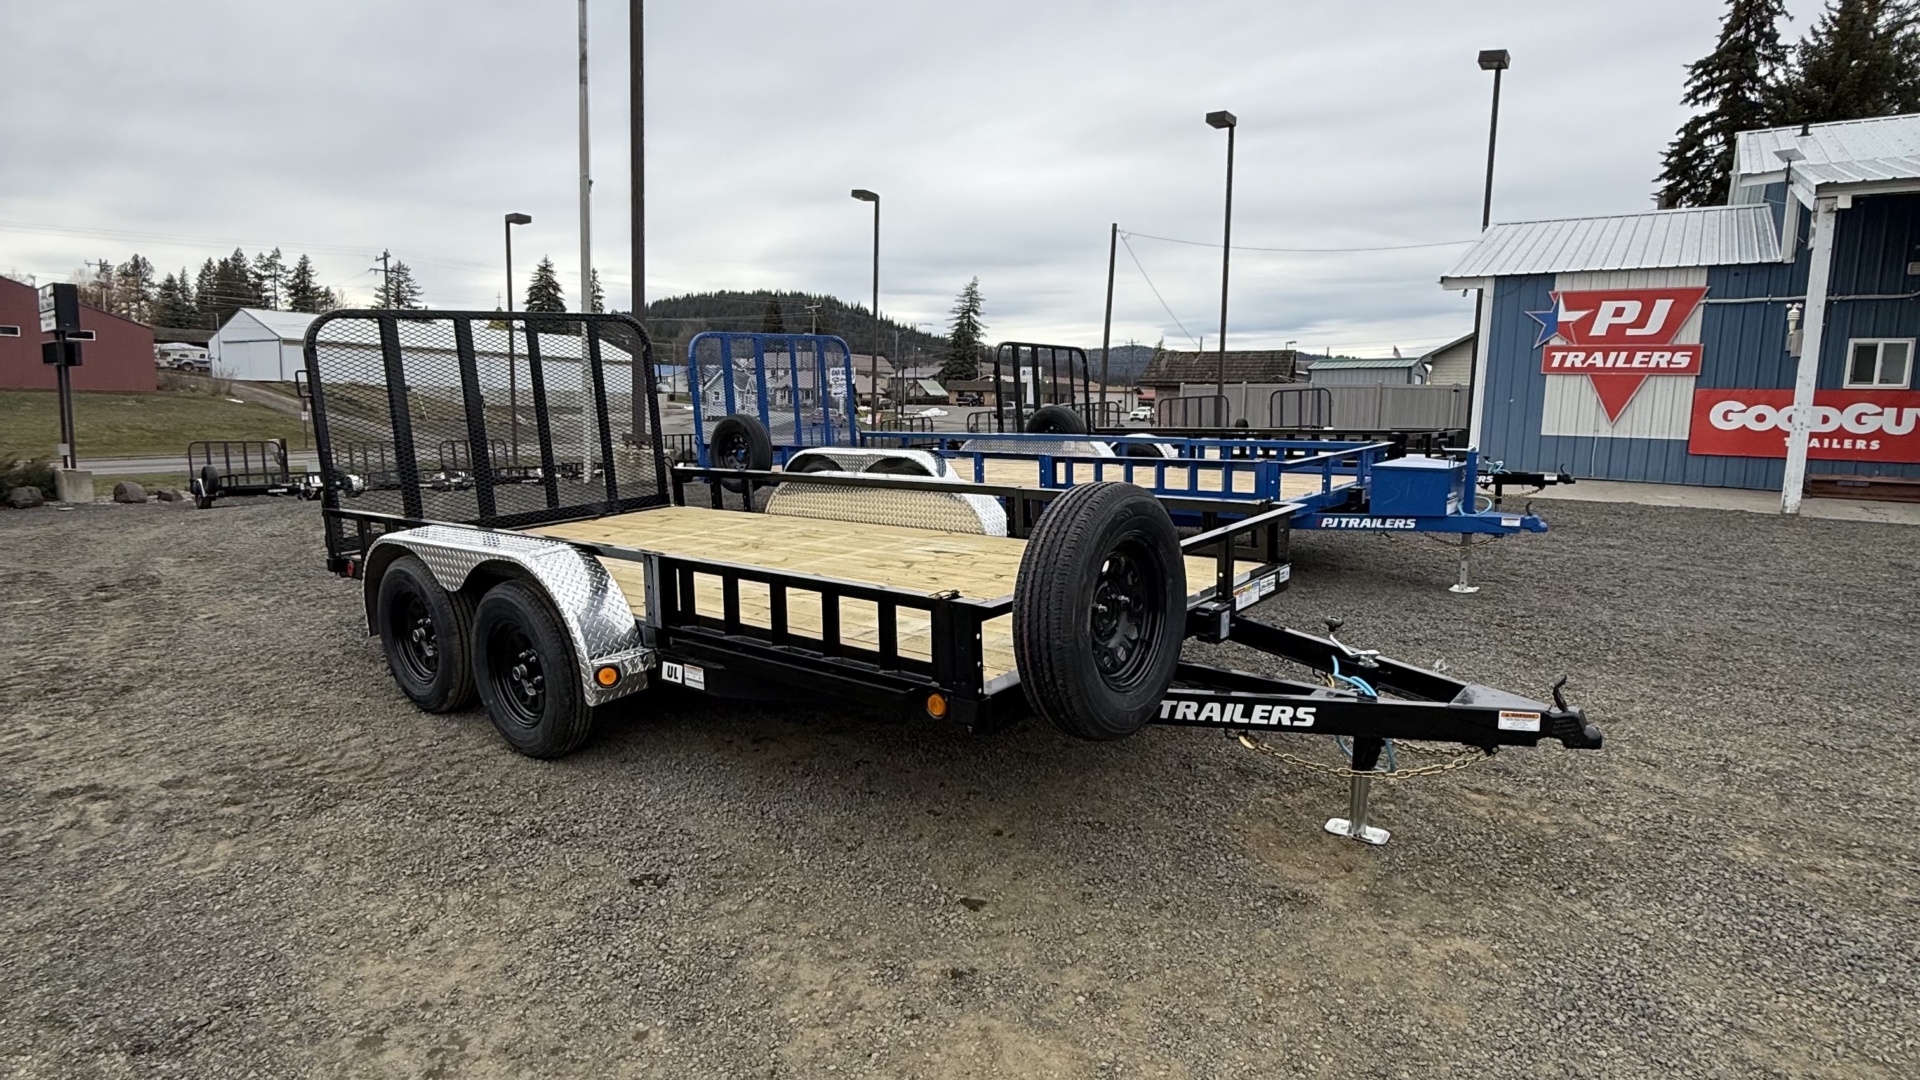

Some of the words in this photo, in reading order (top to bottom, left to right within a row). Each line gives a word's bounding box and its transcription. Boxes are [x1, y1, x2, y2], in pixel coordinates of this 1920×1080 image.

[1588, 299, 1675, 336] PJ
[1550, 351, 1693, 368] TRAILERS
[1709, 400, 1920, 435] GOODGU
[1784, 437, 1881, 450] TAILERS
[667, 665, 678, 680] UL
[1159, 700, 1317, 727] TRAILERS
